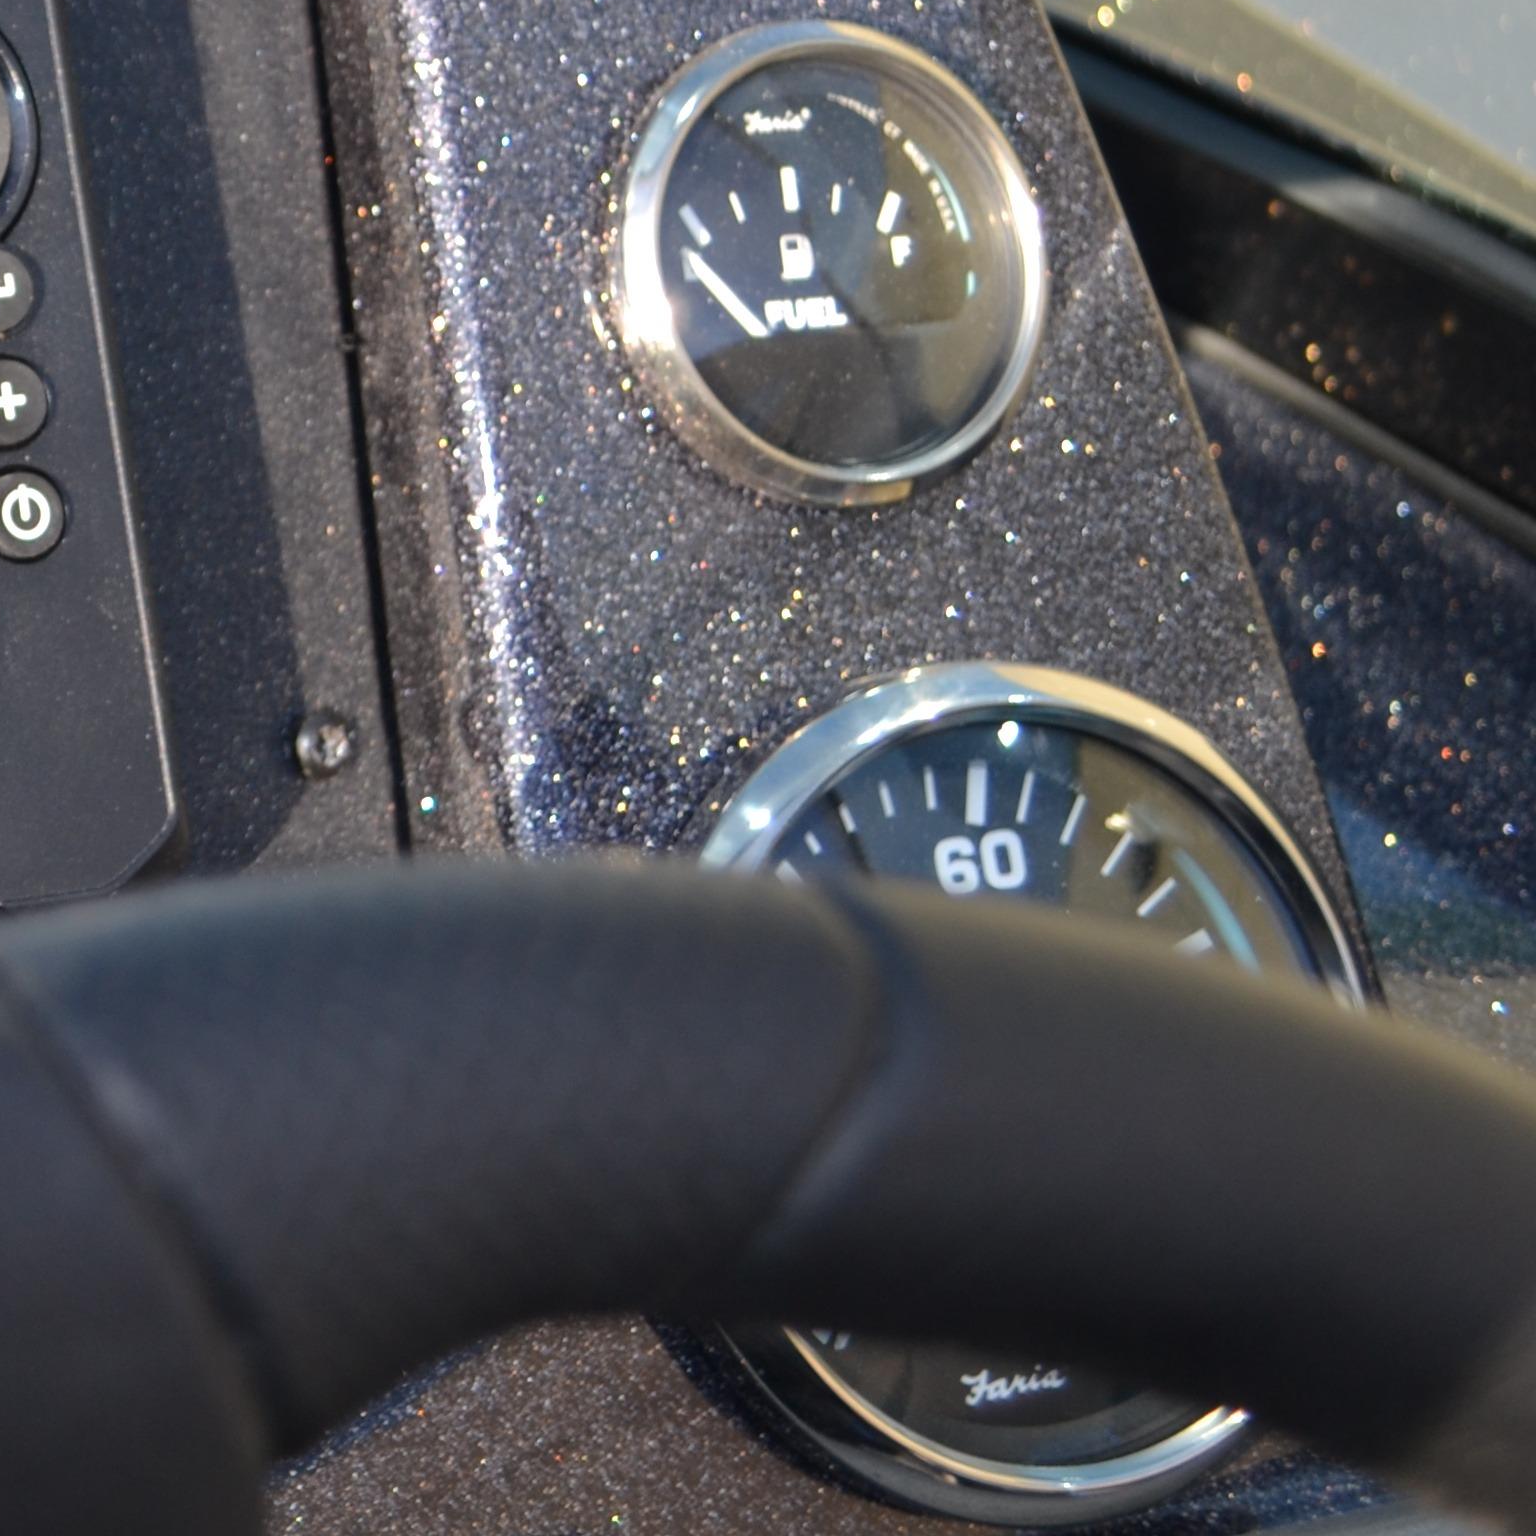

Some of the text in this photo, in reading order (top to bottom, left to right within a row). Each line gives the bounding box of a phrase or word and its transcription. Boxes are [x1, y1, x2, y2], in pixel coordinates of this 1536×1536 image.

[764, 297, 848, 330] FUEL
[934, 828, 1027, 895] 60
[960, 1364, 1066, 1406] Faria
